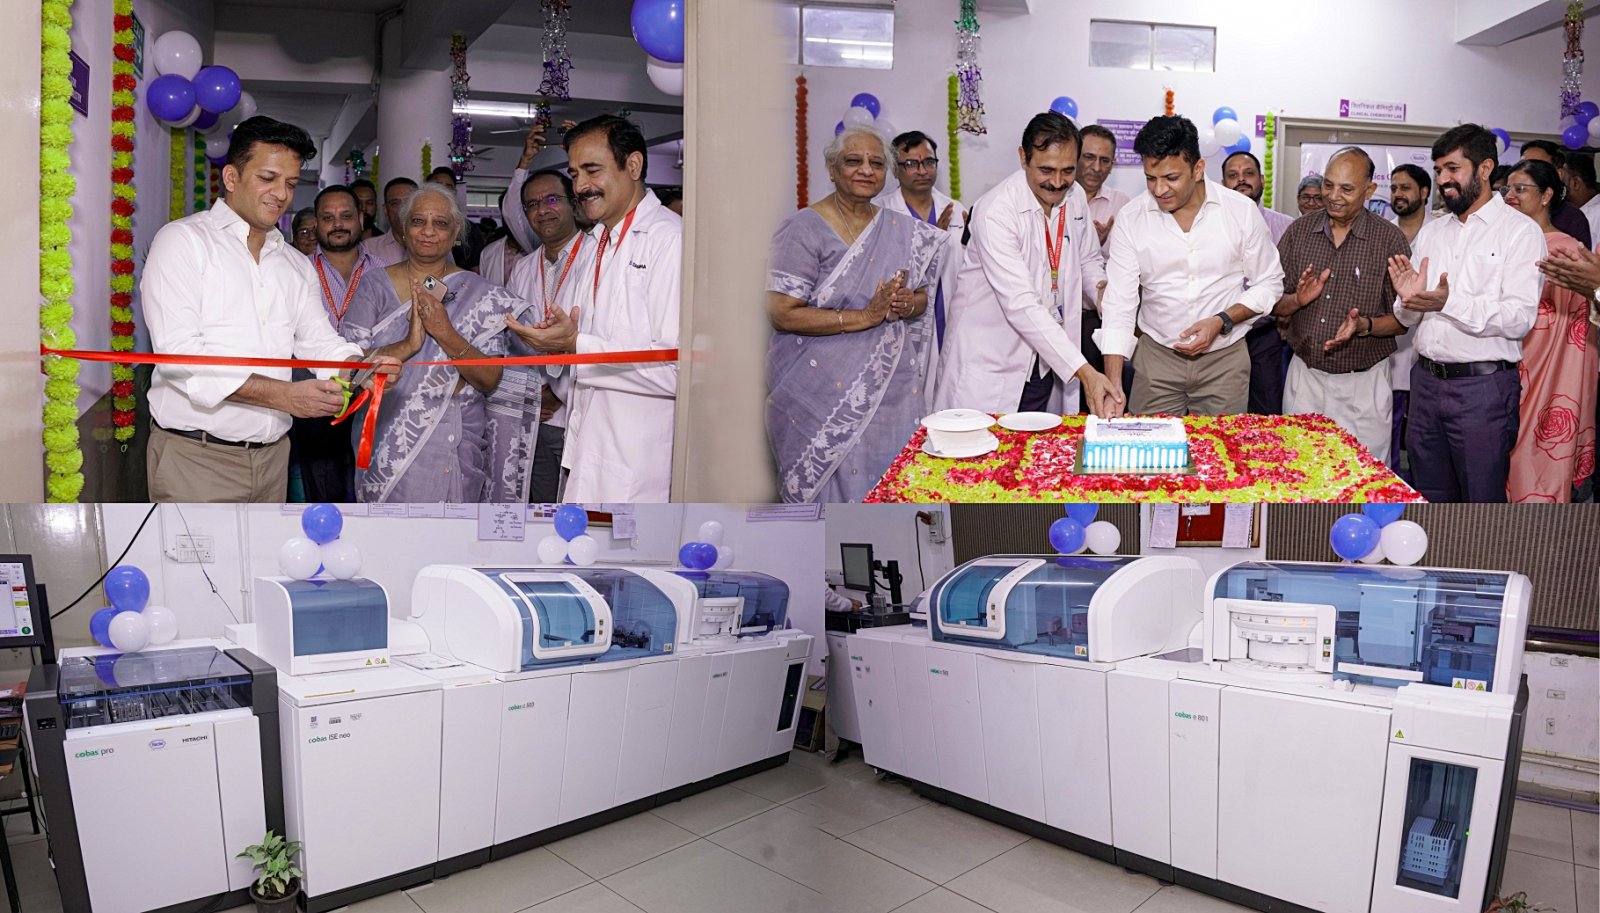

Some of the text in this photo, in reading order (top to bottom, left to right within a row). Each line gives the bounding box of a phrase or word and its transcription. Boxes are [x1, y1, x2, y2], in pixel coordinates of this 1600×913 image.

[1174, 711, 1192, 719] cobas
[1198, 714, 1208, 722] 801
[182, 735, 208, 743] HITACHI
[75, 747, 114, 758] cobas pro
